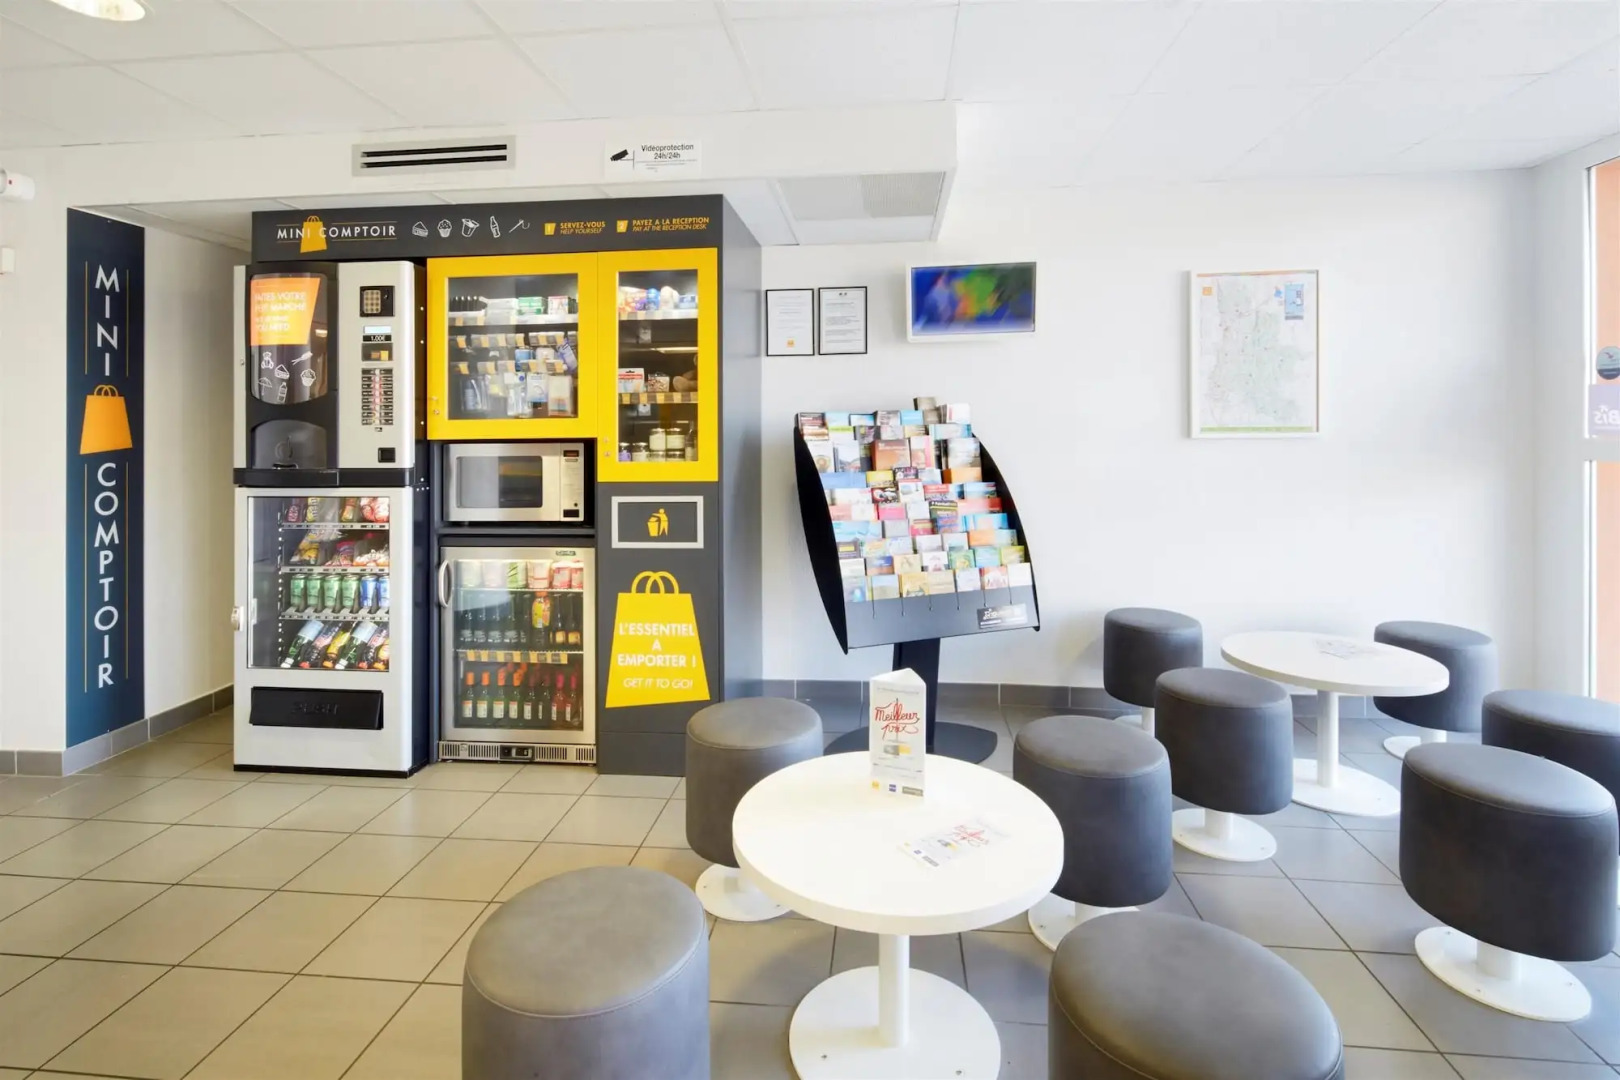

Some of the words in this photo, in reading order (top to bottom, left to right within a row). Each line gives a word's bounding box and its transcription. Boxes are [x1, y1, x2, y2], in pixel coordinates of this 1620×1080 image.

[560, 221, 606, 229] SERVEZ-VOUS
[632, 219, 652, 227] PAYEZ
[672, 217, 710, 225] RECEPTION
[277, 228, 311, 239] MINI
[319, 225, 396, 239] COMPTOIR
[94, 264, 120, 377] MINI
[94, 462, 120, 689] COMPTOIR
[619, 622, 695, 637] L'ESSENTIEL
[651, 638, 662, 651] A
[617, 654, 687, 667] EMPORTER
[623, 678, 643, 688] GET
[644, 678, 652, 688] IT
[656, 678, 669, 688] TO
[672, 679, 693, 689] GO!
